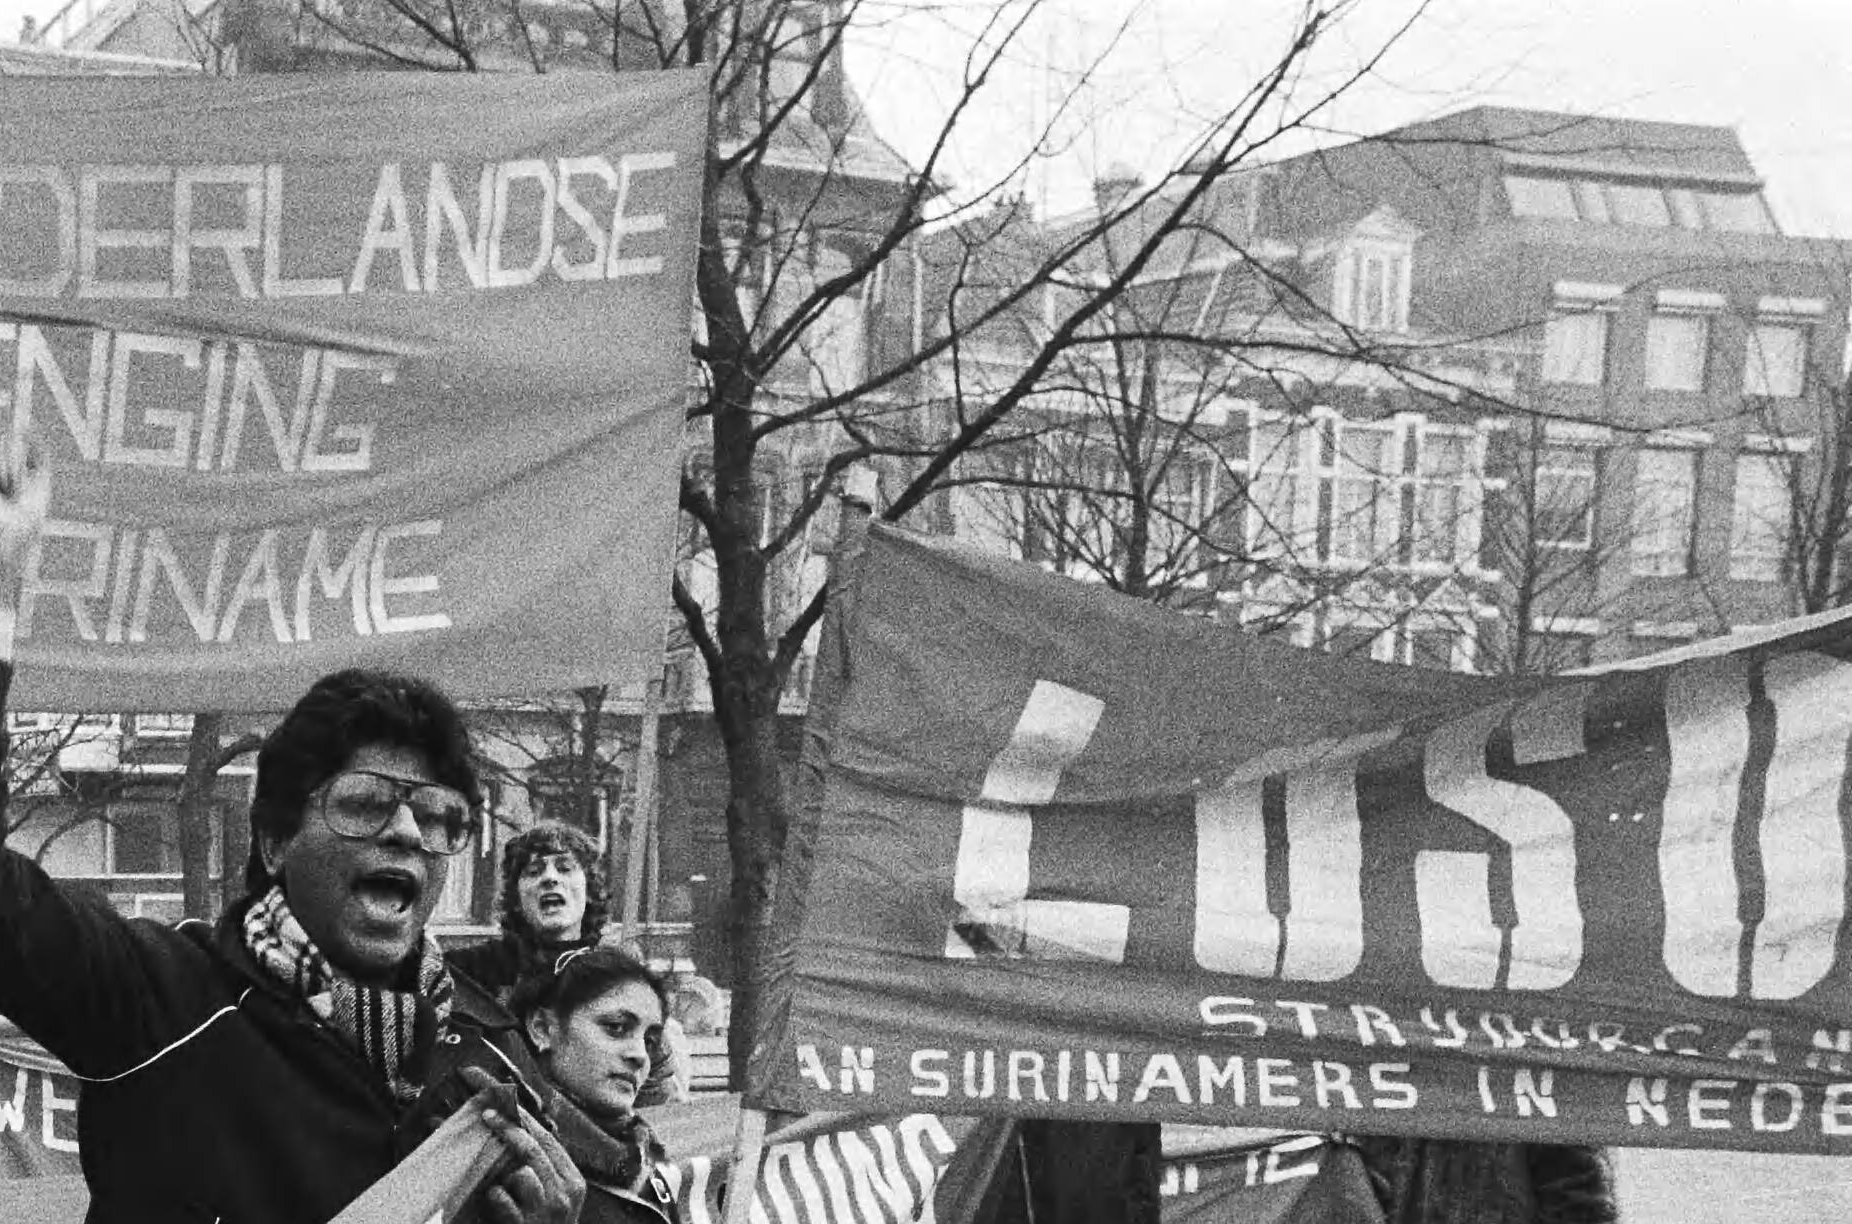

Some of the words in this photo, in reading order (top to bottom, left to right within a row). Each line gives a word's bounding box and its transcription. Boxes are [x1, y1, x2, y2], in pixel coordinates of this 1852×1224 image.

[910, 1048, 1420, 1111] SURINAMERS
[1477, 1064, 1558, 1119] IN
[1625, 1076, 1852, 1137] NEDE
